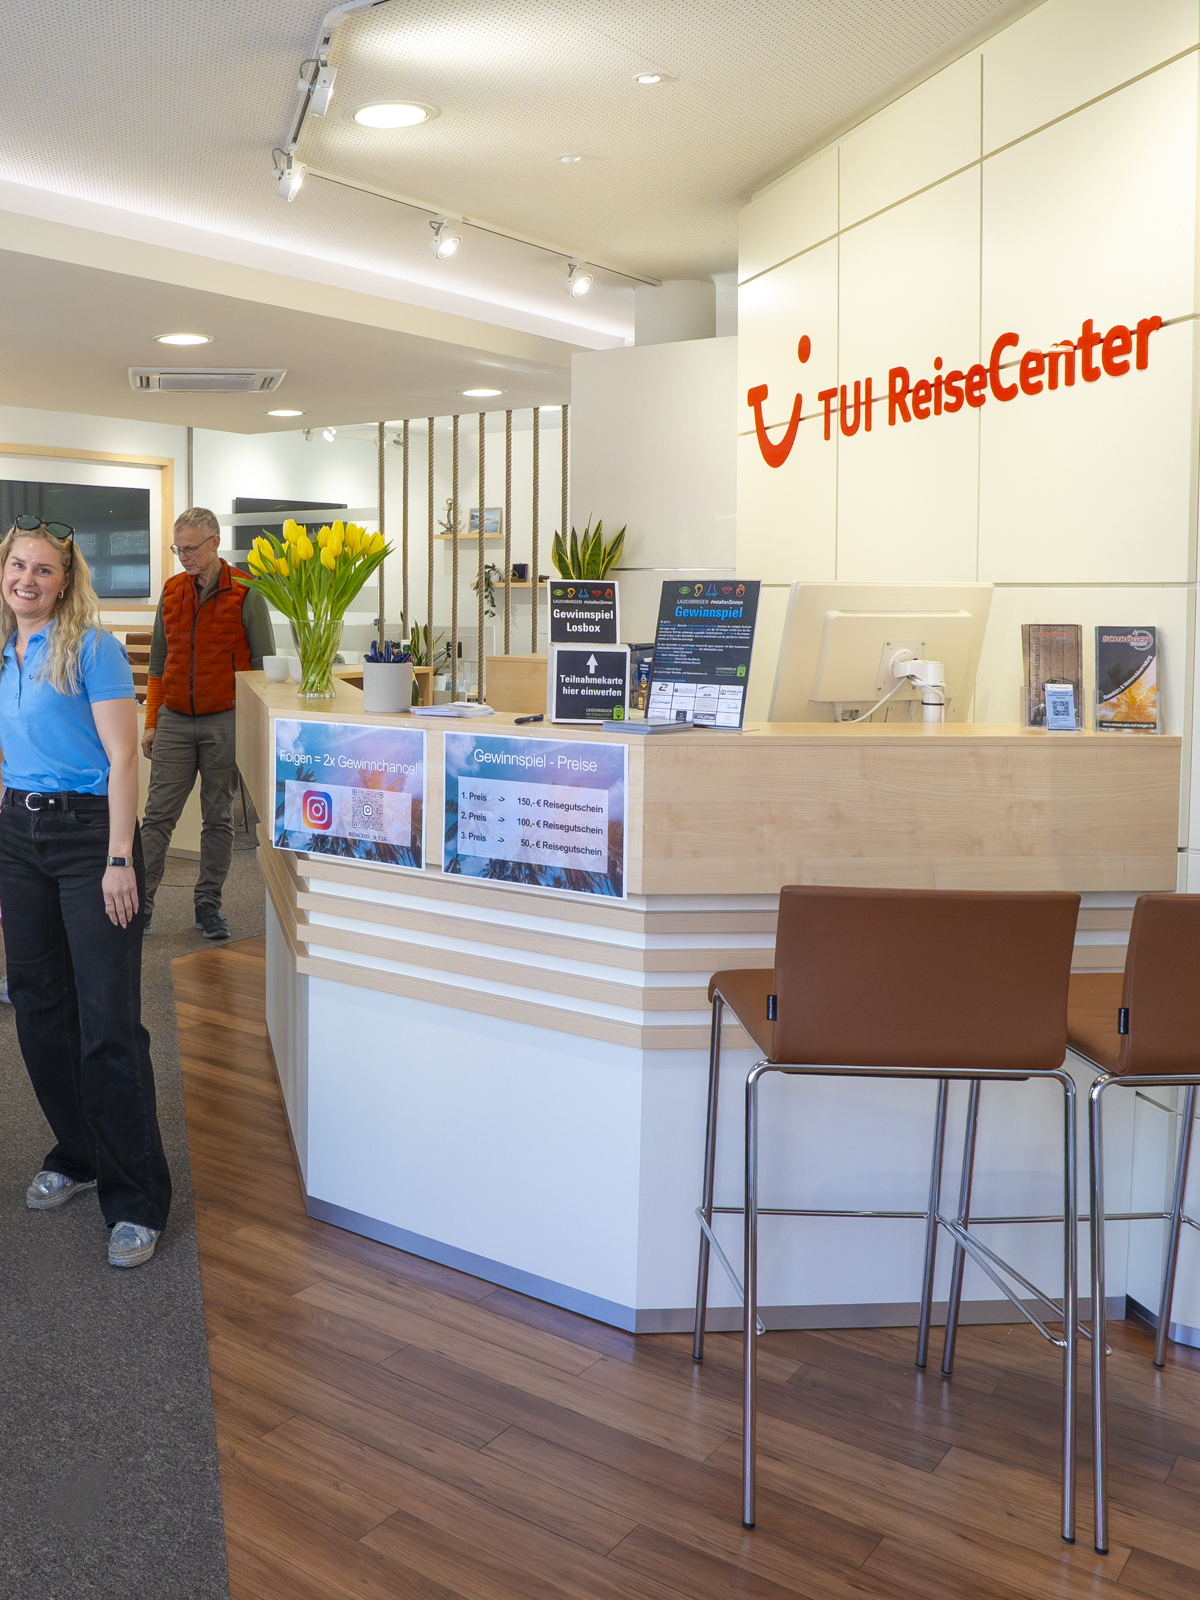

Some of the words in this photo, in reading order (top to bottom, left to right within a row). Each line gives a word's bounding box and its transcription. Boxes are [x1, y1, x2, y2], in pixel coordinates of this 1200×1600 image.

[818, 377, 872, 440] TUI
[888, 315, 1162, 426] ReiseCenter
[553, 608, 614, 622] Gewinnspiel
[675, 606, 743, 620] Gewinnspiel
[566, 622, 600, 632] Losbox
[1102, 634, 1150, 644] SCHRÖGER
[560, 674, 623, 684] Teilnahmekarte
[562, 686, 579, 695] hier
[580, 687, 622, 696] einwerfen
[280, 750, 312, 766] Folgen
[323, 754, 335, 766] 2x
[338, 755, 418, 776] Gewinnchance!
[474, 748, 546, 770] Gewinnspiel
[558, 756, 598, 772] Preise
[462, 792, 468, 800] 1.
[468, 792, 487, 802] Preis
[518, 798, 536, 808] 150,-
[536, 799, 542, 808] €
[543, 800, 604, 814] Reisegutschein
[461, 812, 468, 820] 2.
[468, 812, 487, 822] Preis
[517, 818, 536, 828] 100,-
[536, 820, 542, 828] €
[542, 820, 603, 835] Reisegutschein
[460, 832, 467, 840] 3.
[468, 832, 486, 842] Preis
[520, 838, 535, 848] 50,-
[536, 840, 541, 848] €
[542, 842, 602, 856] Reisegutschein
